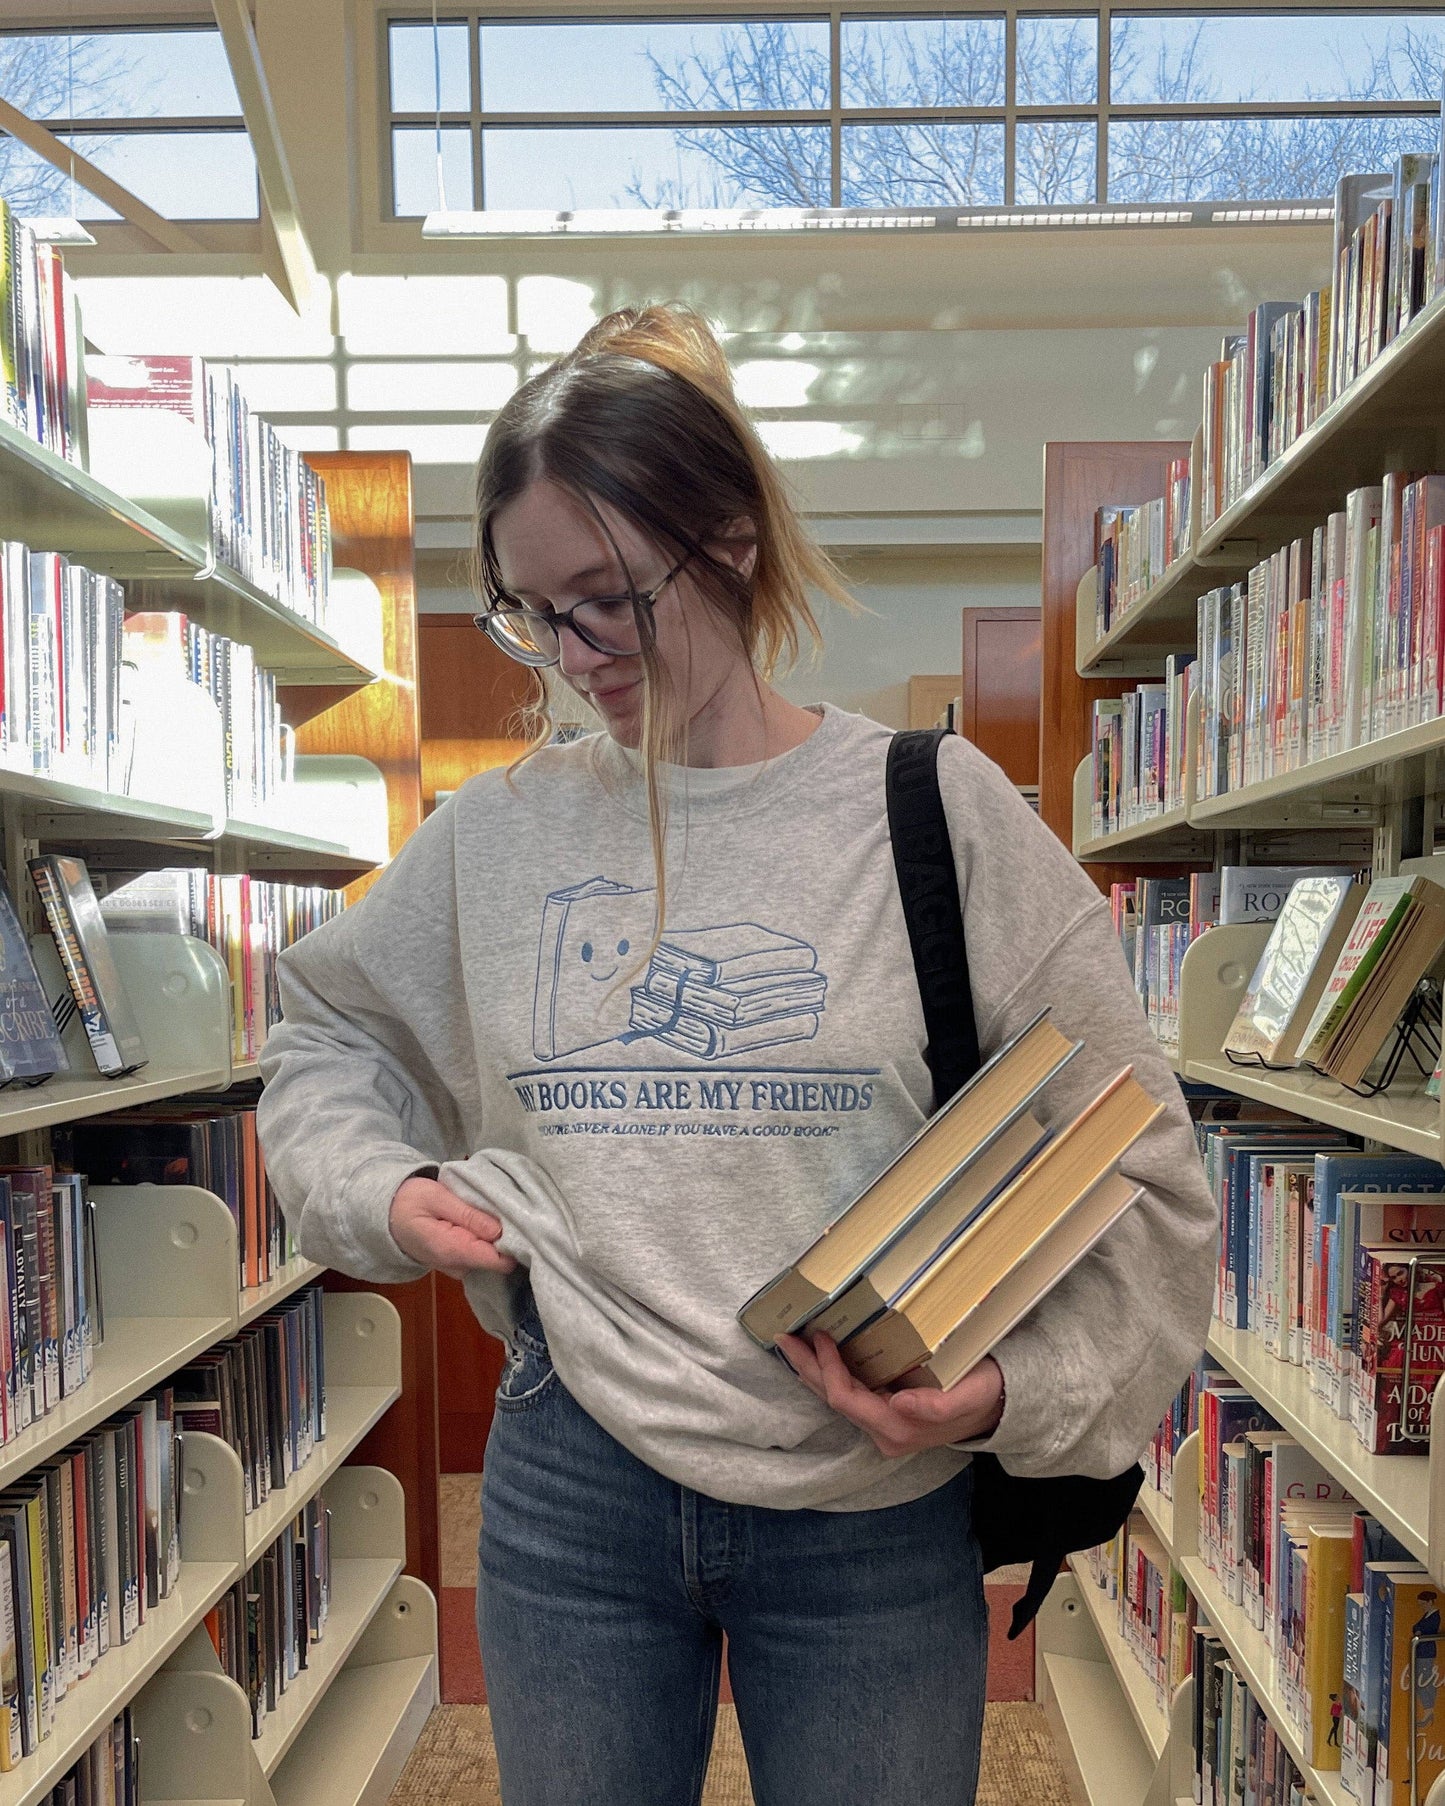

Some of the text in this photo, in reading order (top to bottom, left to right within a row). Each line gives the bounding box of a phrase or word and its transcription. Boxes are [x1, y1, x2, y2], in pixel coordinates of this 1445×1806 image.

[1364, 902, 1377, 915] GET
[538, 1081, 627, 1111] BOOKS
[634, 1080, 692, 1110] ARE
[699, 1081, 743, 1110] MY
[750, 1082, 874, 1111] FRIENDS
[612, 1124, 656, 1136] ALONE
[658, 1124, 672, 1136] IF
[674, 1124, 700, 1135] YOU
[703, 1124, 738, 1136] HAVE
[740, 1126, 749, 1136] A
[753, 1125, 791, 1136] GOOD
[16, 1248, 26, 1308] LOYALTY
[1387, 1385, 1401, 1404] A
[119, 1456, 127, 1488] TODD
[1345, 1621, 1354, 1680] Jordan
